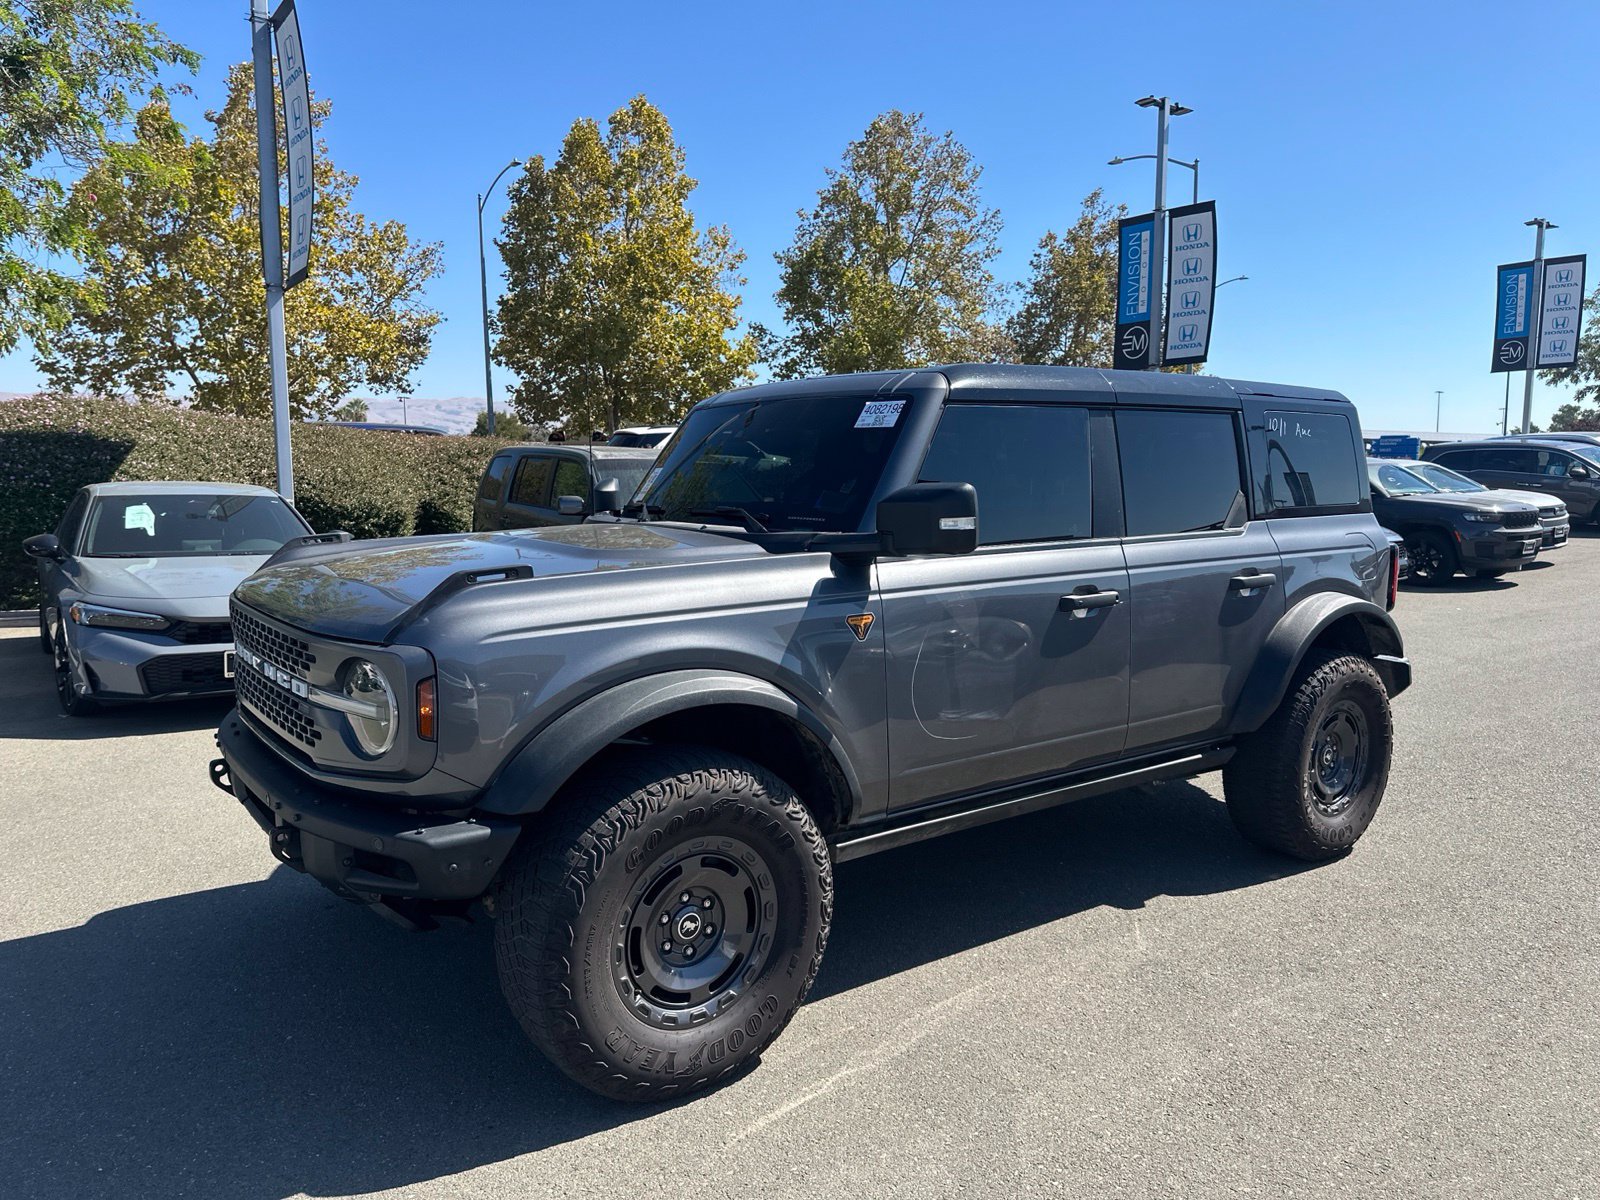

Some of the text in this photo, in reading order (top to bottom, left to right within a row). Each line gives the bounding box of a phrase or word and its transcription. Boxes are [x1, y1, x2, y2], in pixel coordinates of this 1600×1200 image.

[285, 67, 302, 90] HONDA
[290, 127, 309, 148] HONDA
[293, 186, 311, 206] HONDA
[1175, 241, 1210, 252] HONDA
[1126, 231, 1141, 316] ENVISION
[1140, 238, 1149, 307] MOTORS
[1174, 275, 1209, 285] HONDA
[1548, 282, 1579, 290] HONDA
[1172, 309, 1207, 318] HONDA
[1504, 274, 1518, 334] ENVISION
[1169, 342, 1203, 350] HONDA
[605, 994, 779, 1078] GOODYEAR
